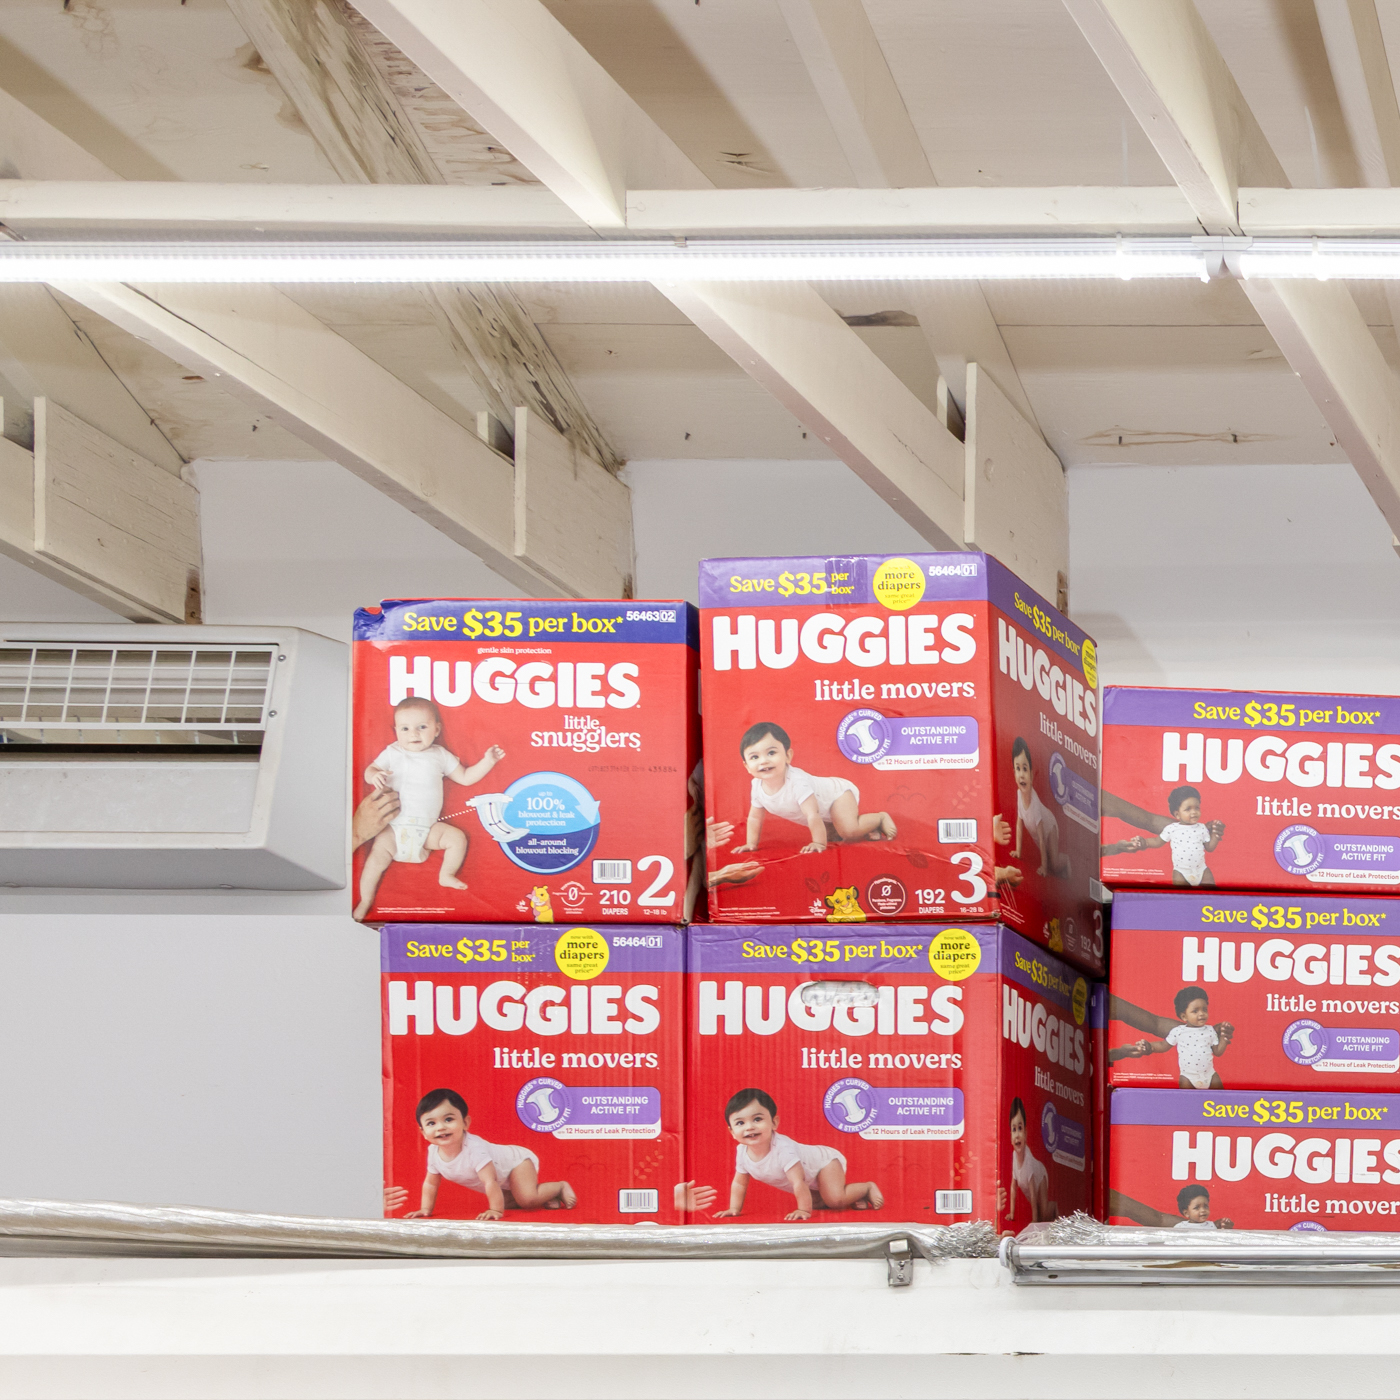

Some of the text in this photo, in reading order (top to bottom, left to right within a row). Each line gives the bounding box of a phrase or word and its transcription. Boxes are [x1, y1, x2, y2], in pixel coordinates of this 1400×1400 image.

[730, 571, 827, 597] Save $35
[831, 573, 849, 583] per
[877, 580, 921, 591] diapers
[884, 571, 915, 580] more
[403, 613, 457, 632] Save
[463, 609, 522, 639] $35
[529, 616, 568, 636] per
[478, 647, 498, 655] gentle
[515, 647, 552, 655] protection
[712, 613, 977, 670] HUGGIES
[389, 656, 640, 708] HUGGIES
[998, 617, 1098, 736] HUGGIES
[814, 679, 975, 701] little movers
[564, 715, 599, 730] little
[1193, 703, 1241, 720] Save
[1243, 700, 1296, 728] $35
[1299, 709, 1333, 726] per
[531, 727, 640, 752] snugglers
[901, 726, 966, 735] OUTSTANDING
[910, 736, 958, 744] ACTIVE FIT
[526, 797, 565, 811] 100%
[1256, 797, 1312, 817] little
[637, 855, 675, 907] 2
[951, 852, 987, 904] 3
[599, 890, 631, 905] 210
[915, 889, 945, 905] 192
[560, 950, 604, 960] diapers
[567, 940, 598, 949] more
[389, 981, 660, 1036] HUGGIES
[1266, 995, 1399, 1016] little movers
[494, 1048, 658, 1069] little movers
[801, 1047, 962, 1069] little movers
[1265, 1193, 1320, 1214] little
